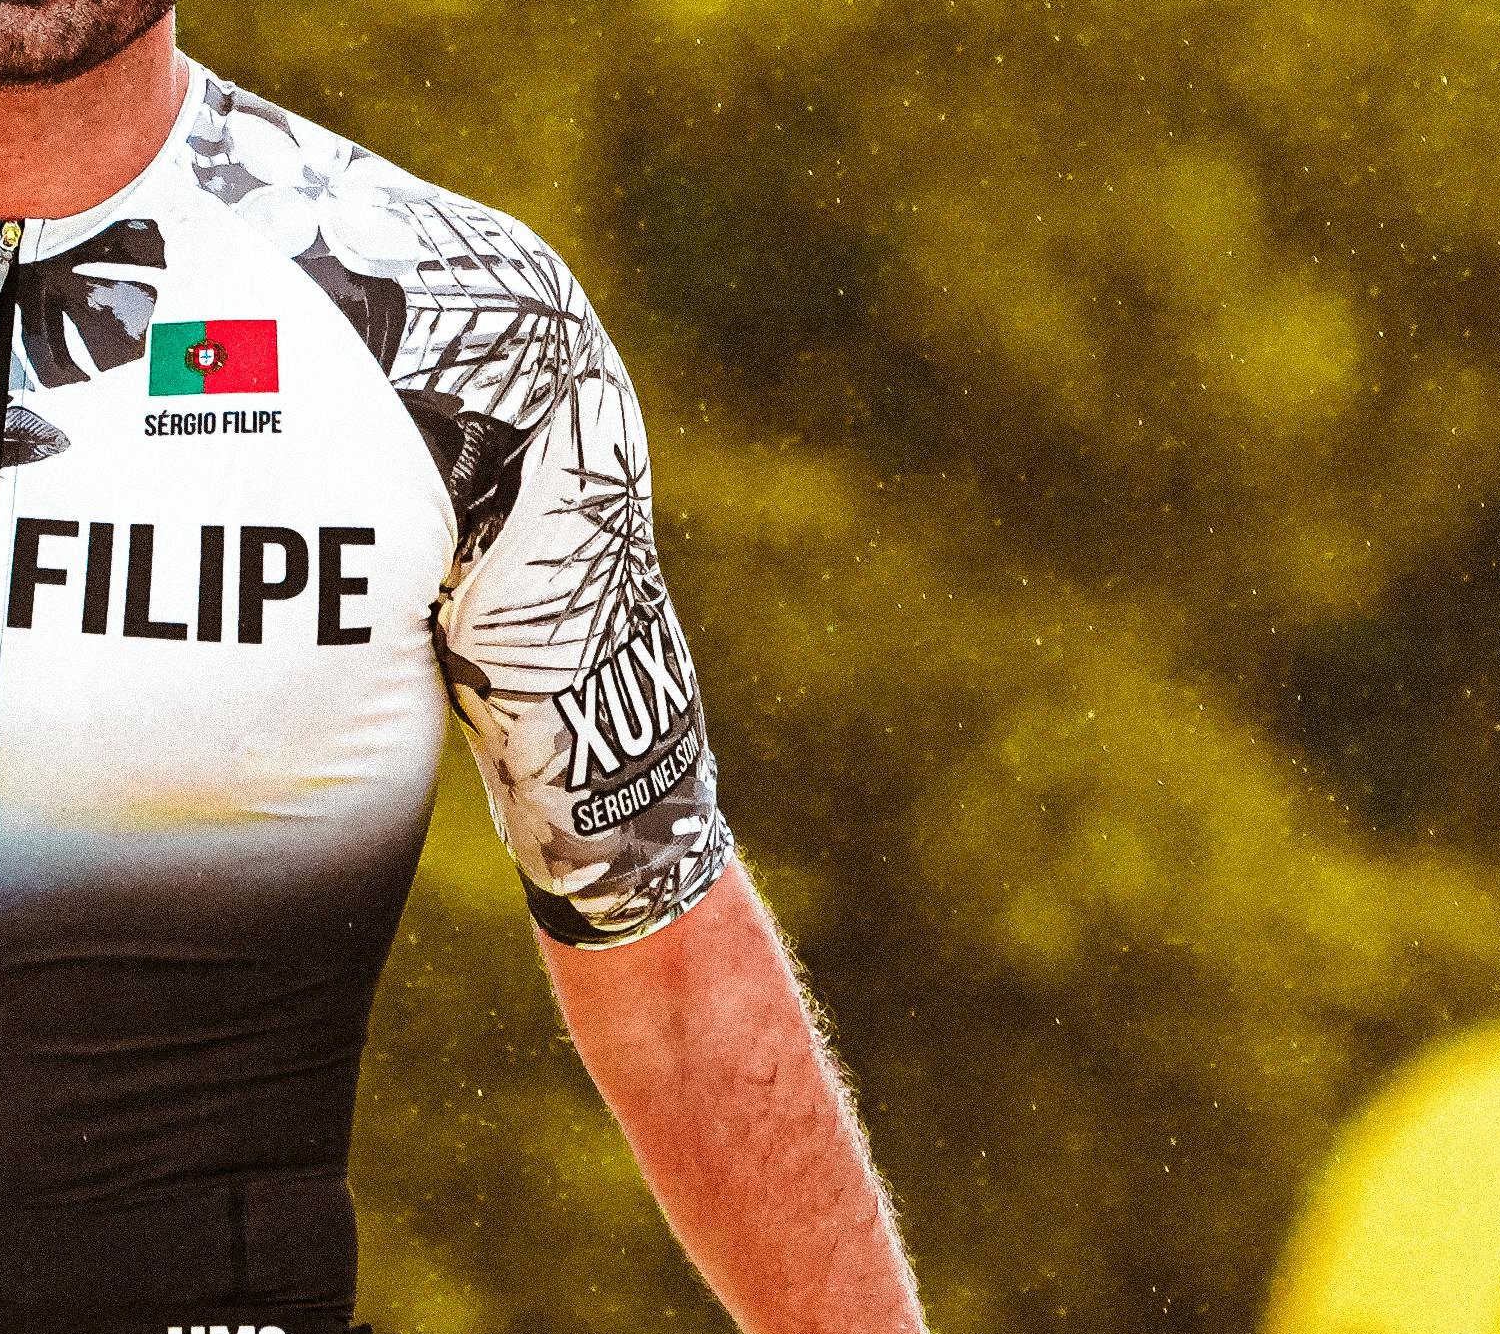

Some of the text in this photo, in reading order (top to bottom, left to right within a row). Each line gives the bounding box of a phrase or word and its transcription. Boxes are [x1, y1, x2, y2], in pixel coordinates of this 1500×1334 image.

[144, 409, 283, 437] SÉRGIO FILIPE
[7, 515, 376, 646] FILIPE
[577, 727, 700, 831] SÉRGIO NELSON
